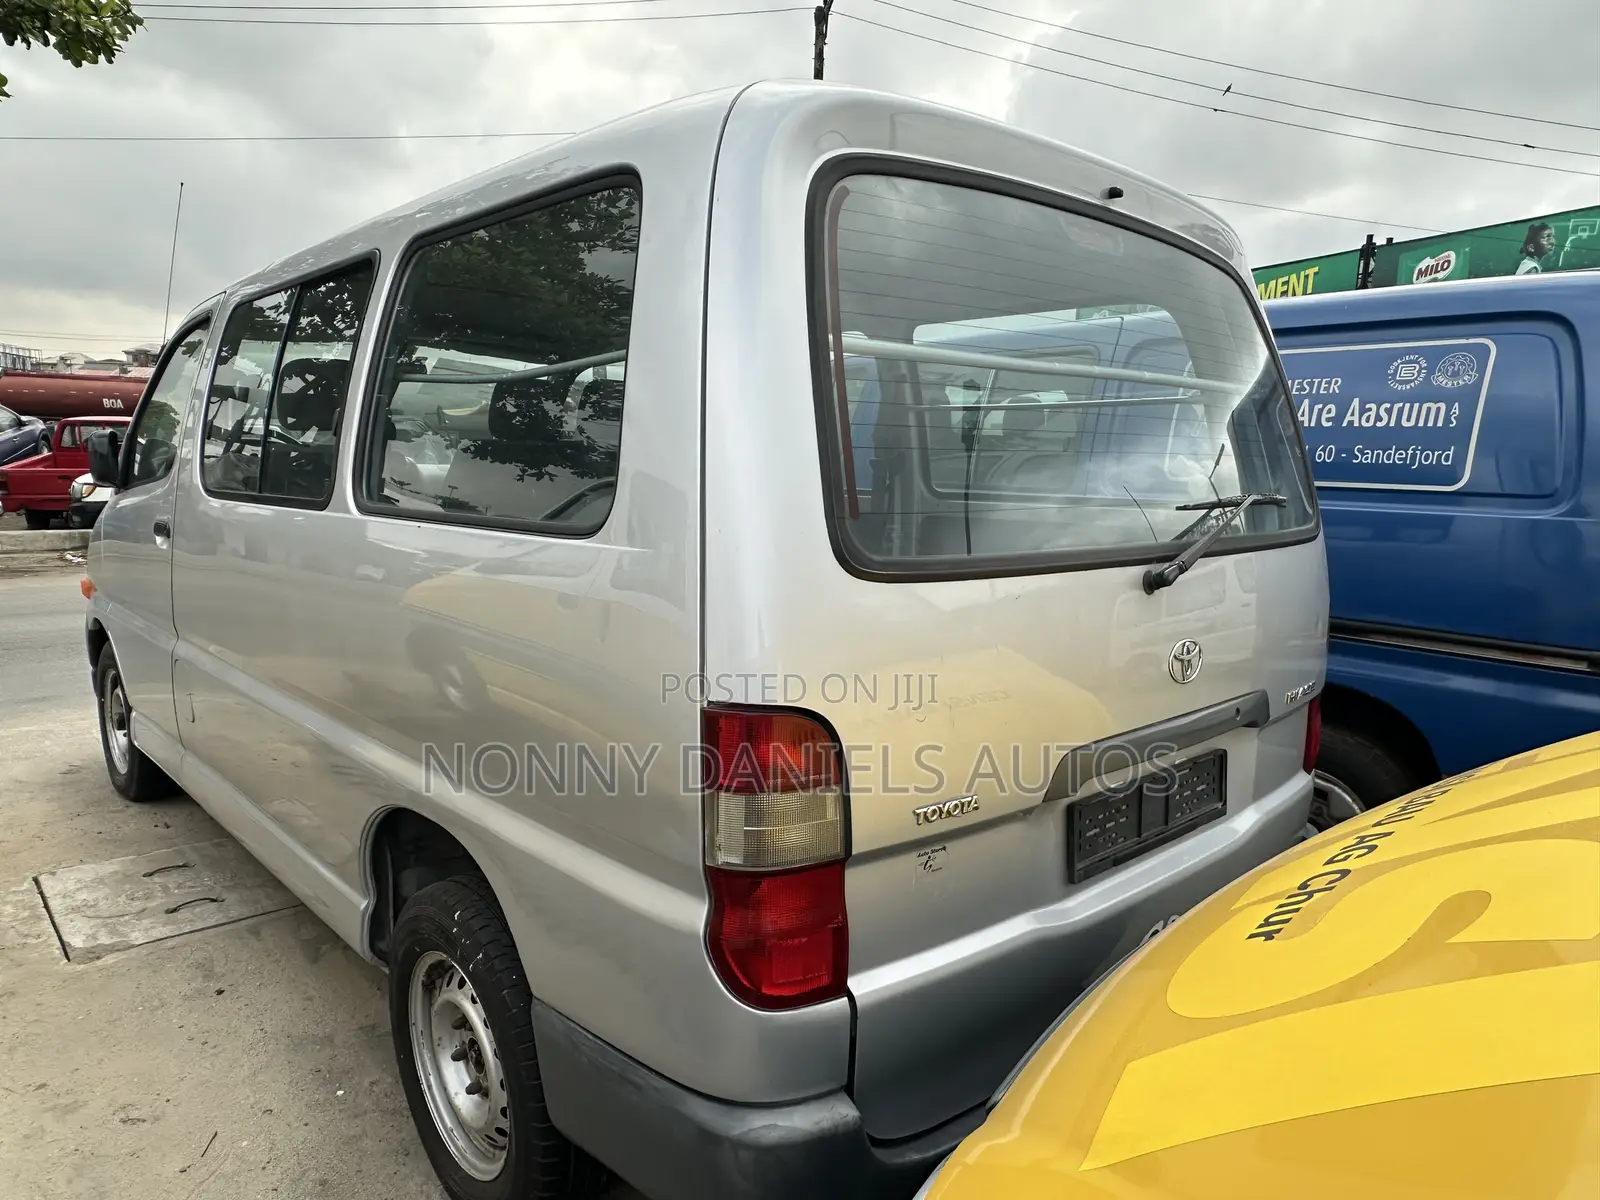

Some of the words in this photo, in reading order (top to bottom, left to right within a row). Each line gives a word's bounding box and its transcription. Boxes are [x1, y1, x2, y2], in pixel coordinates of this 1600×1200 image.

[1416, 259, 1452, 281] MILO
[1288, 377, 1342, 395] ESTER
[103, 398, 124, 409] BOA
[1297, 398, 1336, 427] Are
[1342, 397, 1447, 428] Aasrum
[1315, 444, 1336, 463] 60
[1352, 445, 1455, 469] Sandefjord
[912, 794, 980, 826] TOYOTA
[1322, 830, 1396, 867] AG
[1245, 868, 1352, 942] Chur
